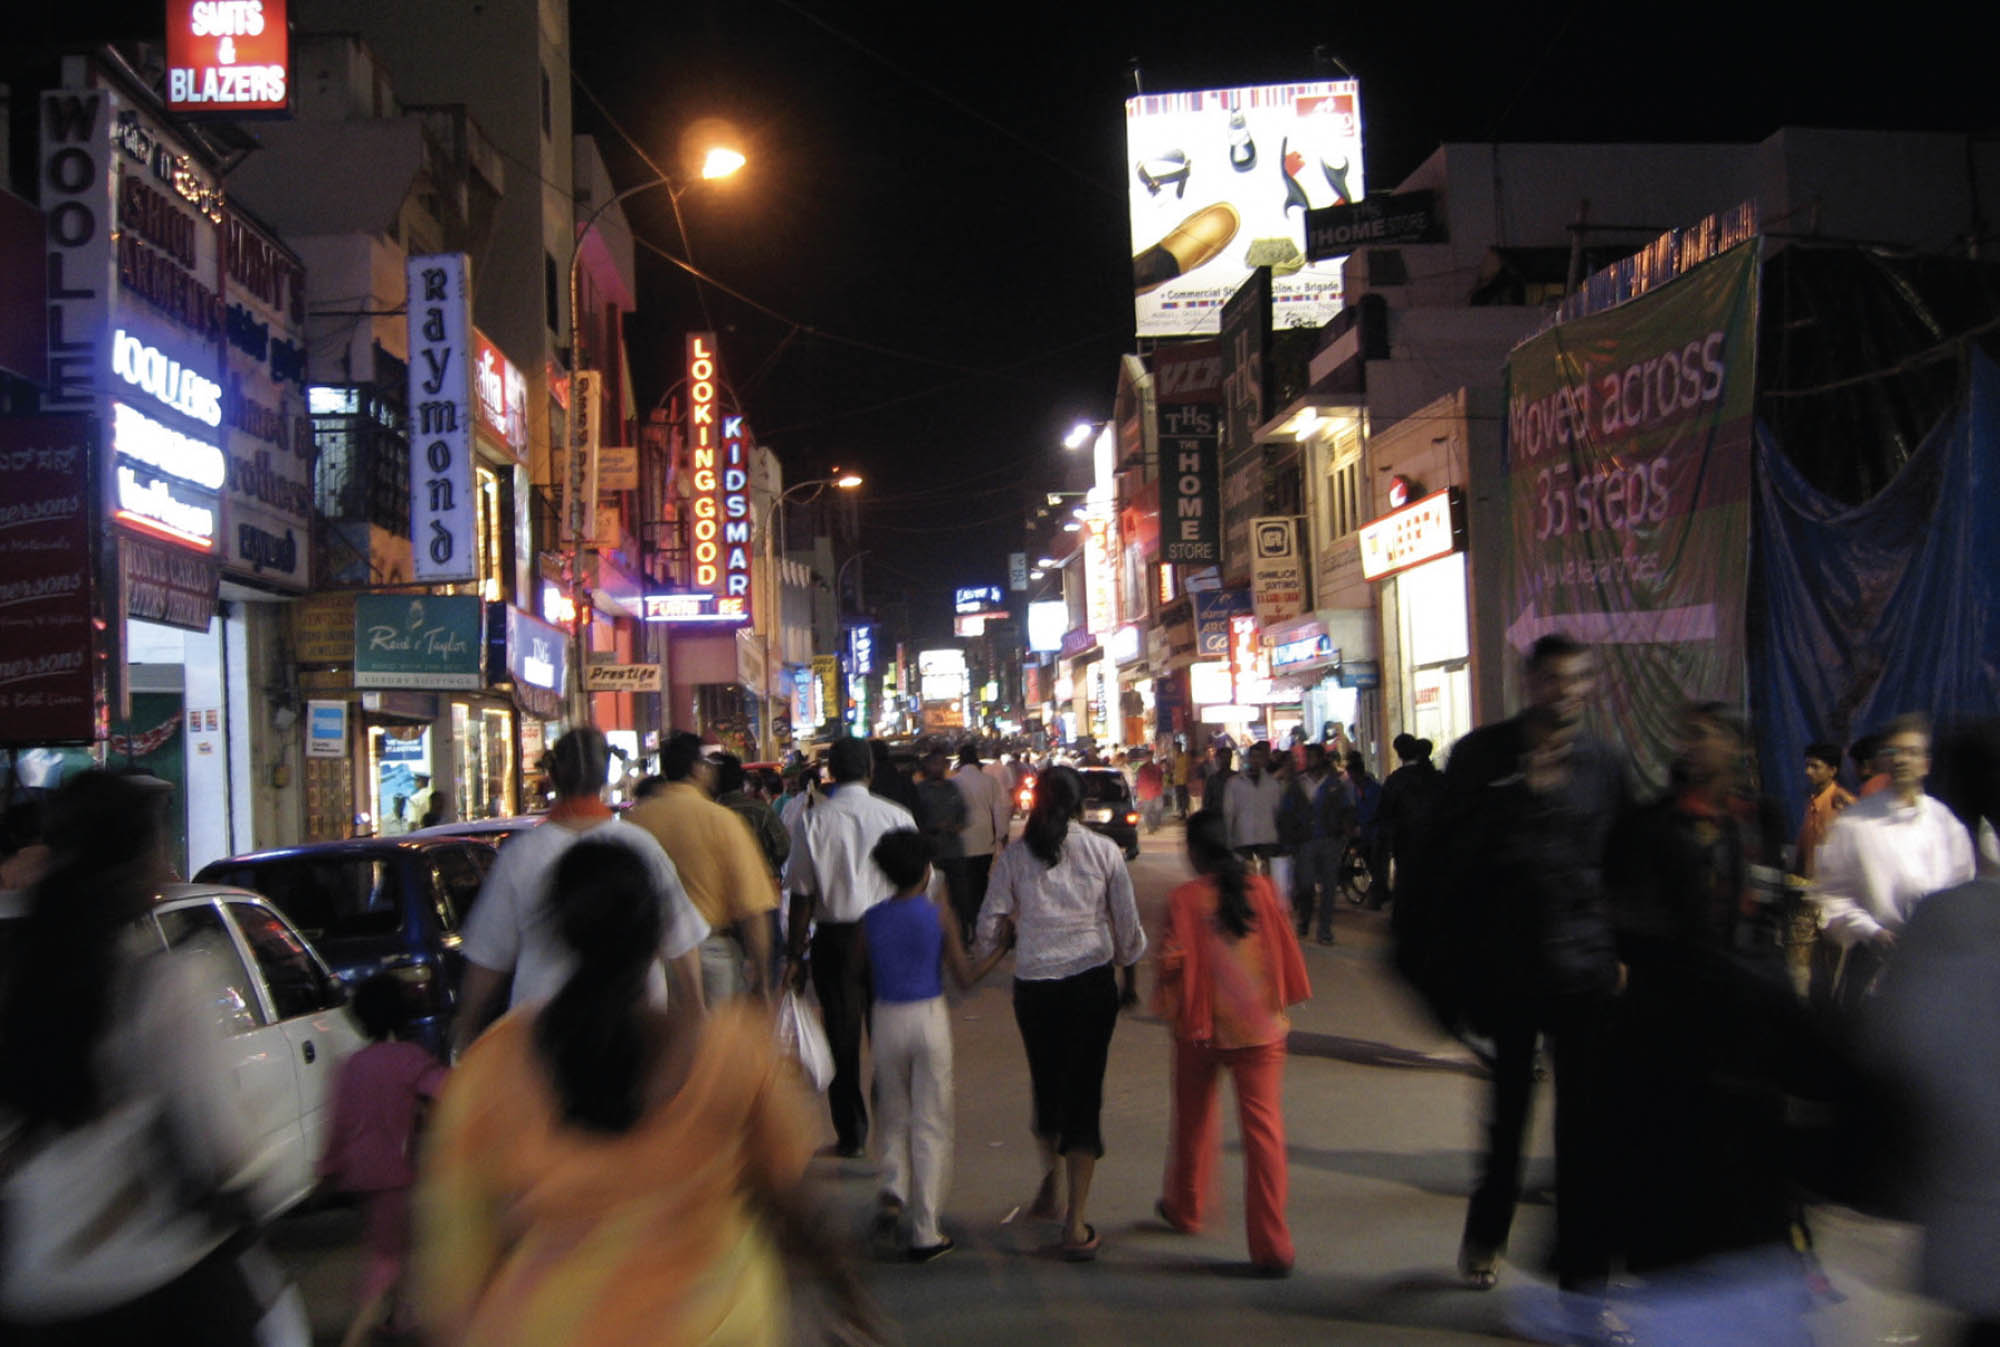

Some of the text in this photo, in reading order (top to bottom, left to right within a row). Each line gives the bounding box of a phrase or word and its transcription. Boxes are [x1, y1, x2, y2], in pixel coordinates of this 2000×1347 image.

[191, 0, 264, 36] SUITS
[218, 37, 236, 65] &
[170, 65, 286, 103] BLAZERS
[1318, 217, 1385, 248] HOME
[1167, 287, 1221, 300] Commercial
[1304, 280, 1339, 293] Brigade
[692, 338, 716, 491] LOOKING
[1510, 331, 1725, 460] Moved across
[417, 267, 458, 567] Raymond
[1177, 451, 1203, 541] HOME
[1536, 463, 1569, 541] 35
[695, 497, 717, 585] GOOD
[1167, 542, 1215, 560] STORE
[367, 624, 412, 651] Reid
[423, 625, 468, 662] Taylor
[590, 666, 656, 682] Prestige
